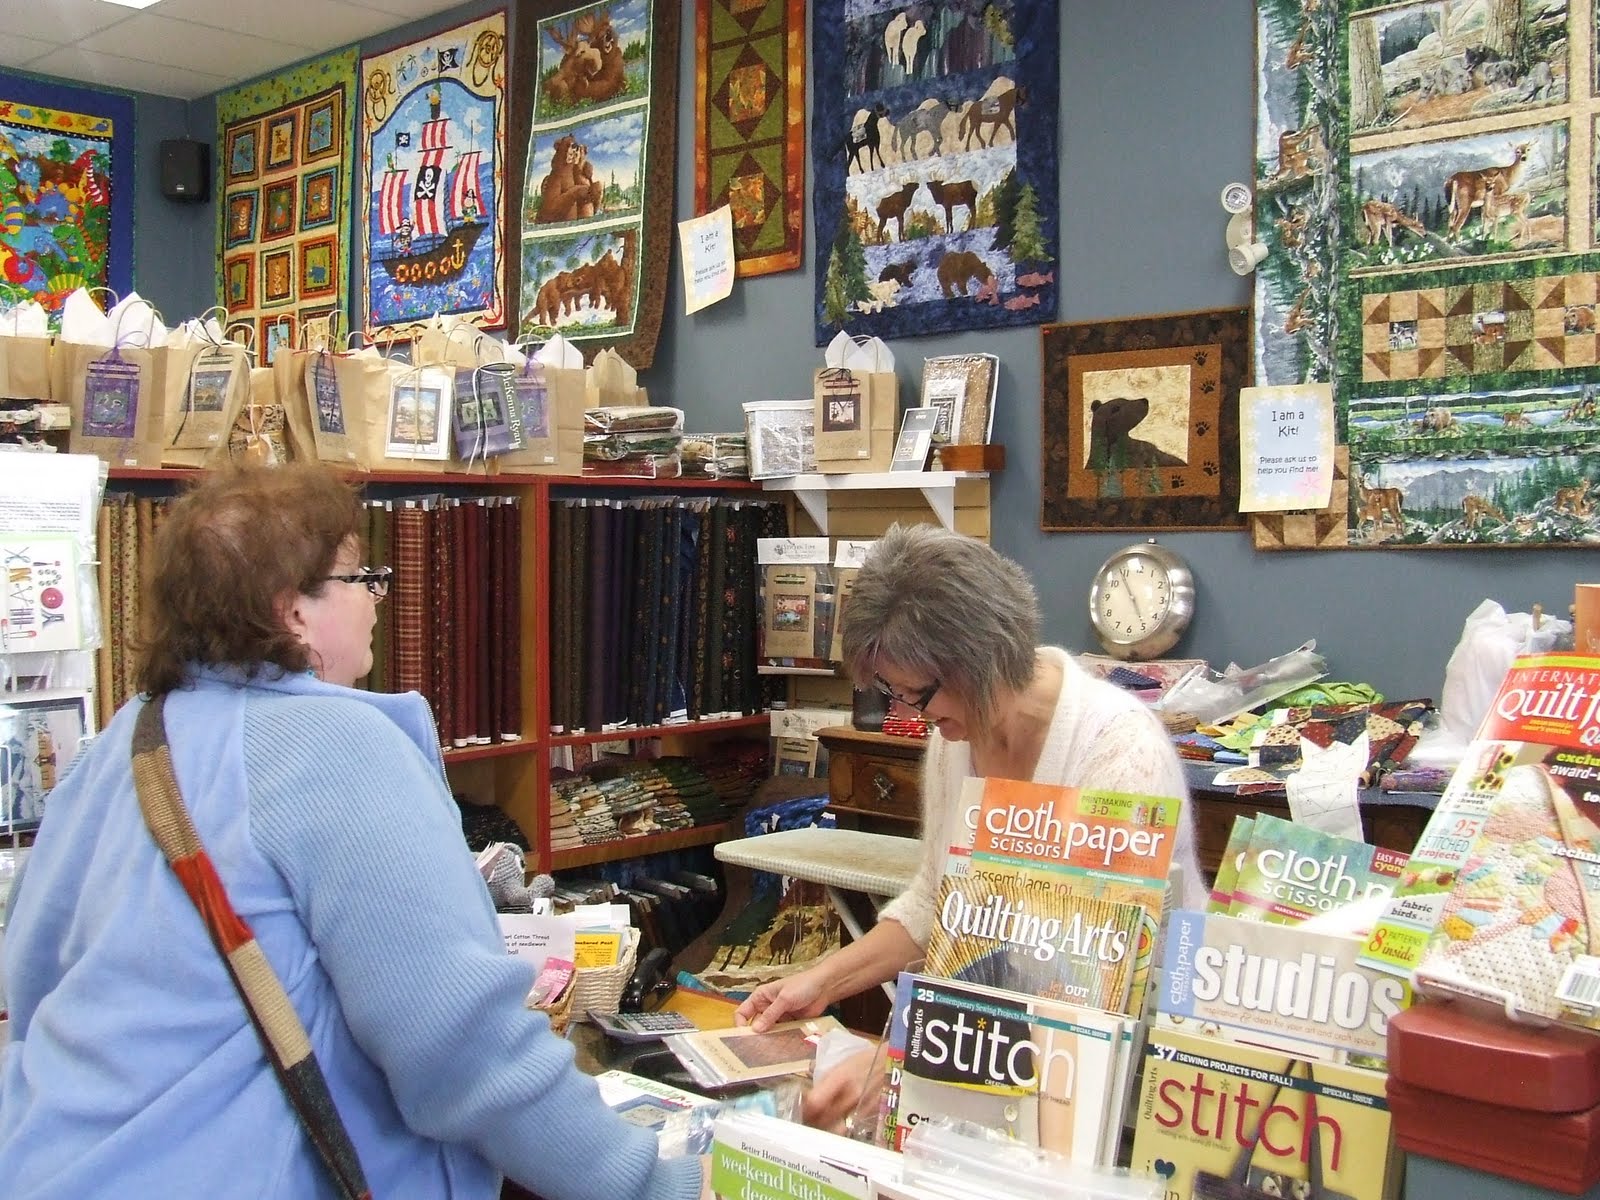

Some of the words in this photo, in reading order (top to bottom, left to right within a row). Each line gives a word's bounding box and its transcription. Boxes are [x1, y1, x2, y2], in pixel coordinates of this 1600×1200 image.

[1272, 410, 1277, 422] I
[1279, 411, 1295, 421] am
[1299, 411, 1305, 420] a
[510, 418, 522, 447] Ryan
[1278, 425, 1299, 438] Kit!
[1259, 456, 1283, 465] Please
[1284, 455, 1297, 463] ask
[1257, 467, 1273, 475] help
[1274, 467, 1288, 475] you
[1110, 580, 1119, 588] 10
[1157, 581, 1164, 590] 2
[1104, 593, 1111, 601] 9
[1159, 597, 1165, 605] 3
[1106, 609, 1112, 617] 8
[1152, 613, 1158, 621] 4
[1115, 621, 1121, 629] 7
[1126, 625, 1132, 634] 6
[1140, 622, 1146, 631] 5
[1497, 682, 1588, 722] Quilt
[1081, 794, 1133, 810] PRINTMAKING
[1089, 805, 1110, 817] 3-D
[1451, 818, 1480, 839] 25
[990, 838, 1062, 860] scissors
[1062, 822, 1165, 866] paper
[1376, 852, 1394, 863] EASY
[1417, 847, 1461, 862] projects
[972, 868, 1051, 894] assemblage
[1401, 899, 1434, 914] fabric
[1368, 928, 1388, 953] 8
[1387, 931, 1424, 947] PATTERNS
[1381, 943, 1415, 963] inside
[1065, 984, 1090, 998] OUT
[1191, 943, 1405, 1038] studios
[917, 987, 935, 1003] 25
[935, 993, 976, 1013] Contemporary
[974, 1002, 998, 1018] Sewing
[997, 1007, 1021, 1022] Projects
[1253, 1015, 1273, 1026] ideas
[1273, 1017, 1283, 1028] for
[1283, 1021, 1304, 1033] your
[1303, 1024, 1316, 1034] art
[1315, 1027, 1333, 1038] and
[1333, 1031, 1353, 1043] craft
[1353, 1036, 1377, 1048] space
[920, 1012, 1076, 1100] stitch
[1153, 1043, 1178, 1063] 37
[1209, 1059, 1251, 1078] PROJECTS
[1250, 1069, 1269, 1082] FOR
[1321, 1086, 1351, 1100] SPECIAL
[1352, 1094, 1374, 1106] ISSUE
[1154, 1072, 1344, 1172] stitch
[741, 1141, 761, 1157] Better
[761, 1149, 787, 1168] Homes
[787, 1160, 801, 1172] and
[721, 1154, 785, 1193] weekend
